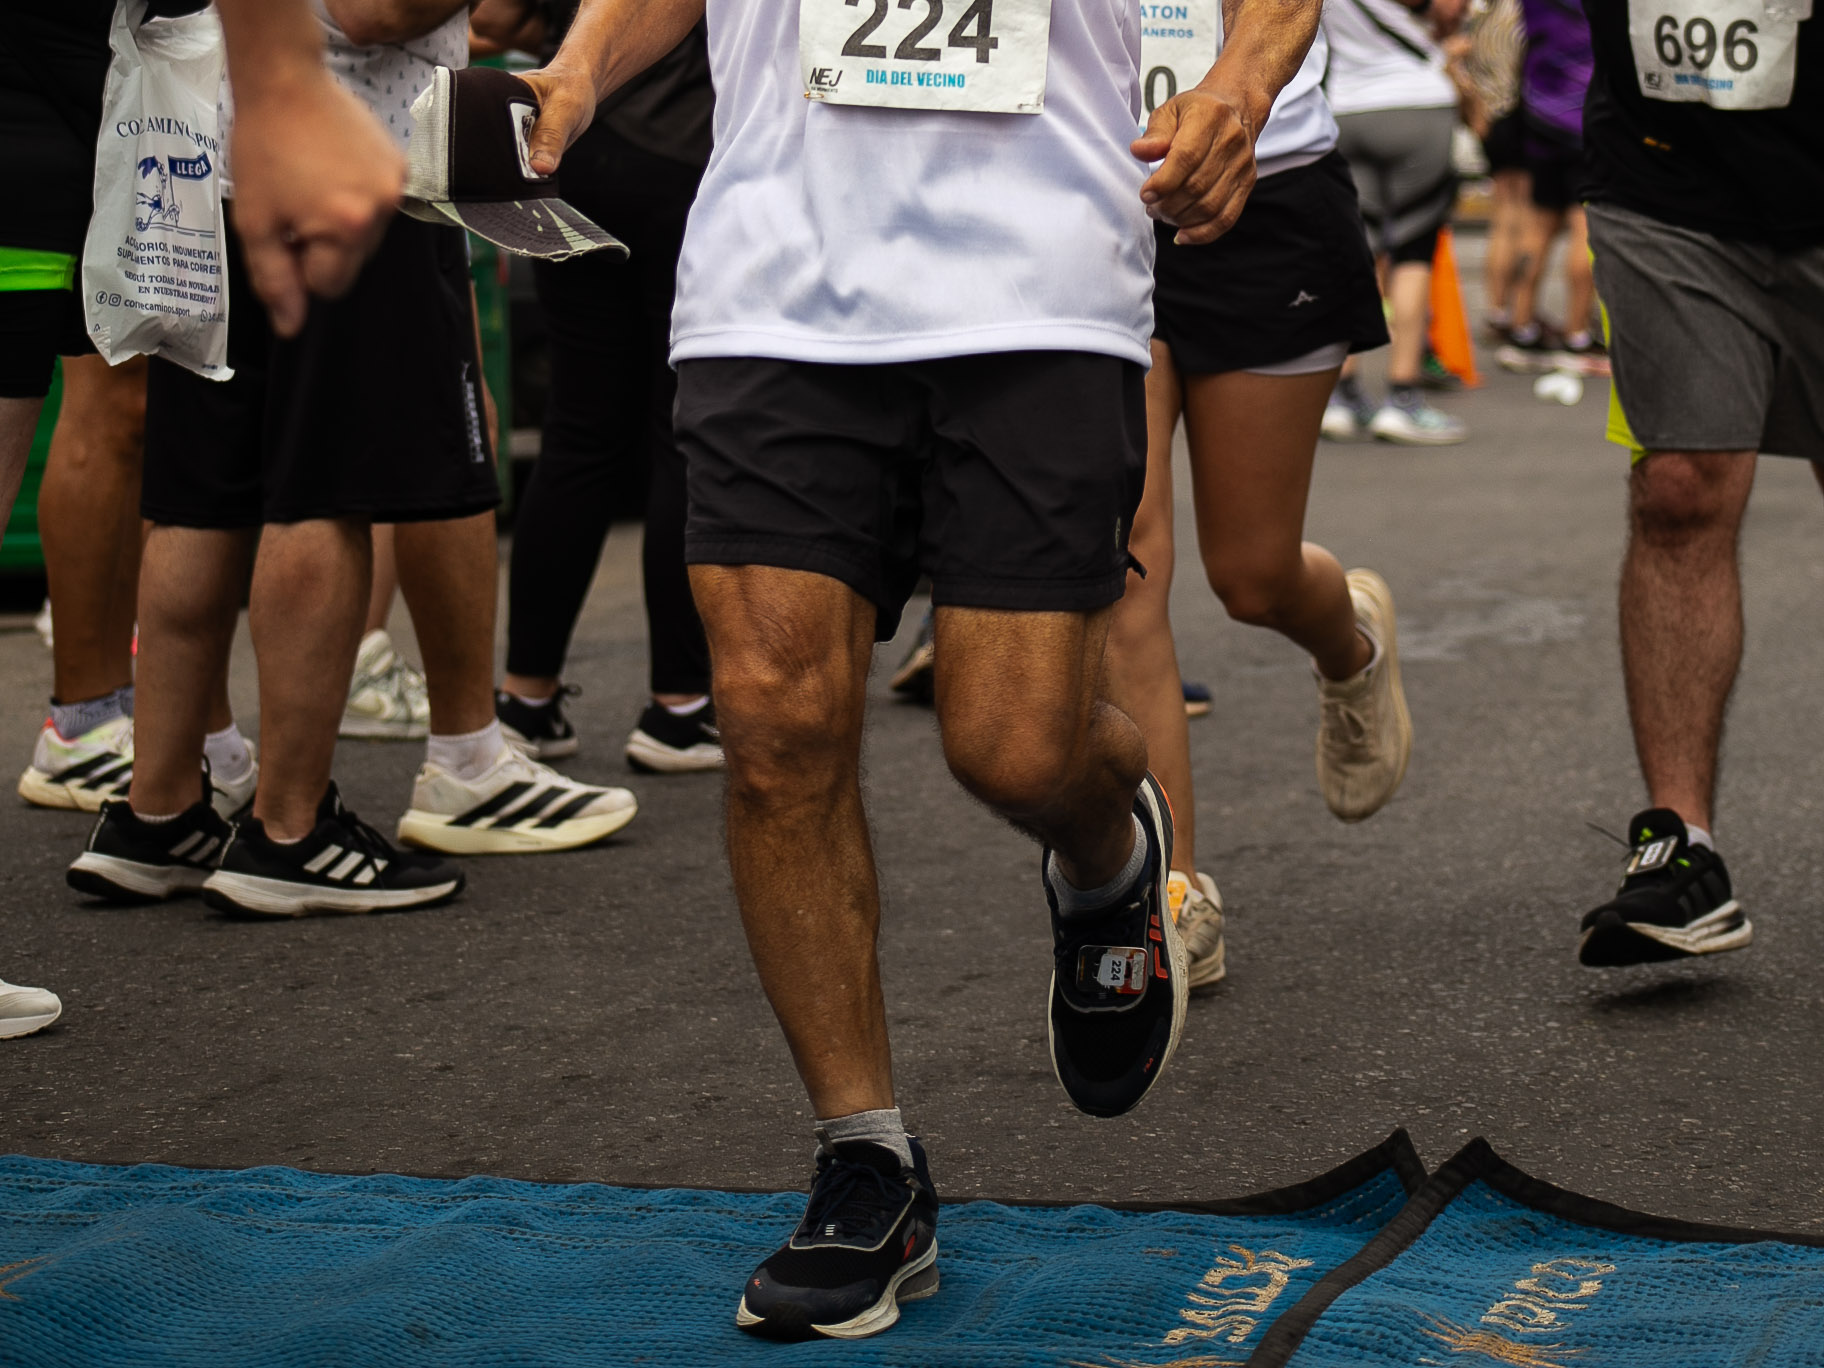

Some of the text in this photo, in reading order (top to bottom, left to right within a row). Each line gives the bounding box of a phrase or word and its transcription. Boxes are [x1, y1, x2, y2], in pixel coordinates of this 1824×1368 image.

[1653, 14, 1759, 73] 696
[809, 66, 844, 88] NEJ
[866, 69, 966, 88] DIA DEL VECINO
[176, 160, 208, 176] LLEGA
[172, 258, 189, 271] PARA
[138, 286, 151, 294] EN
[148, 275, 175, 285] TODAS
[176, 278, 187, 288] LAS
[1110, 960, 1122, 981] 224
